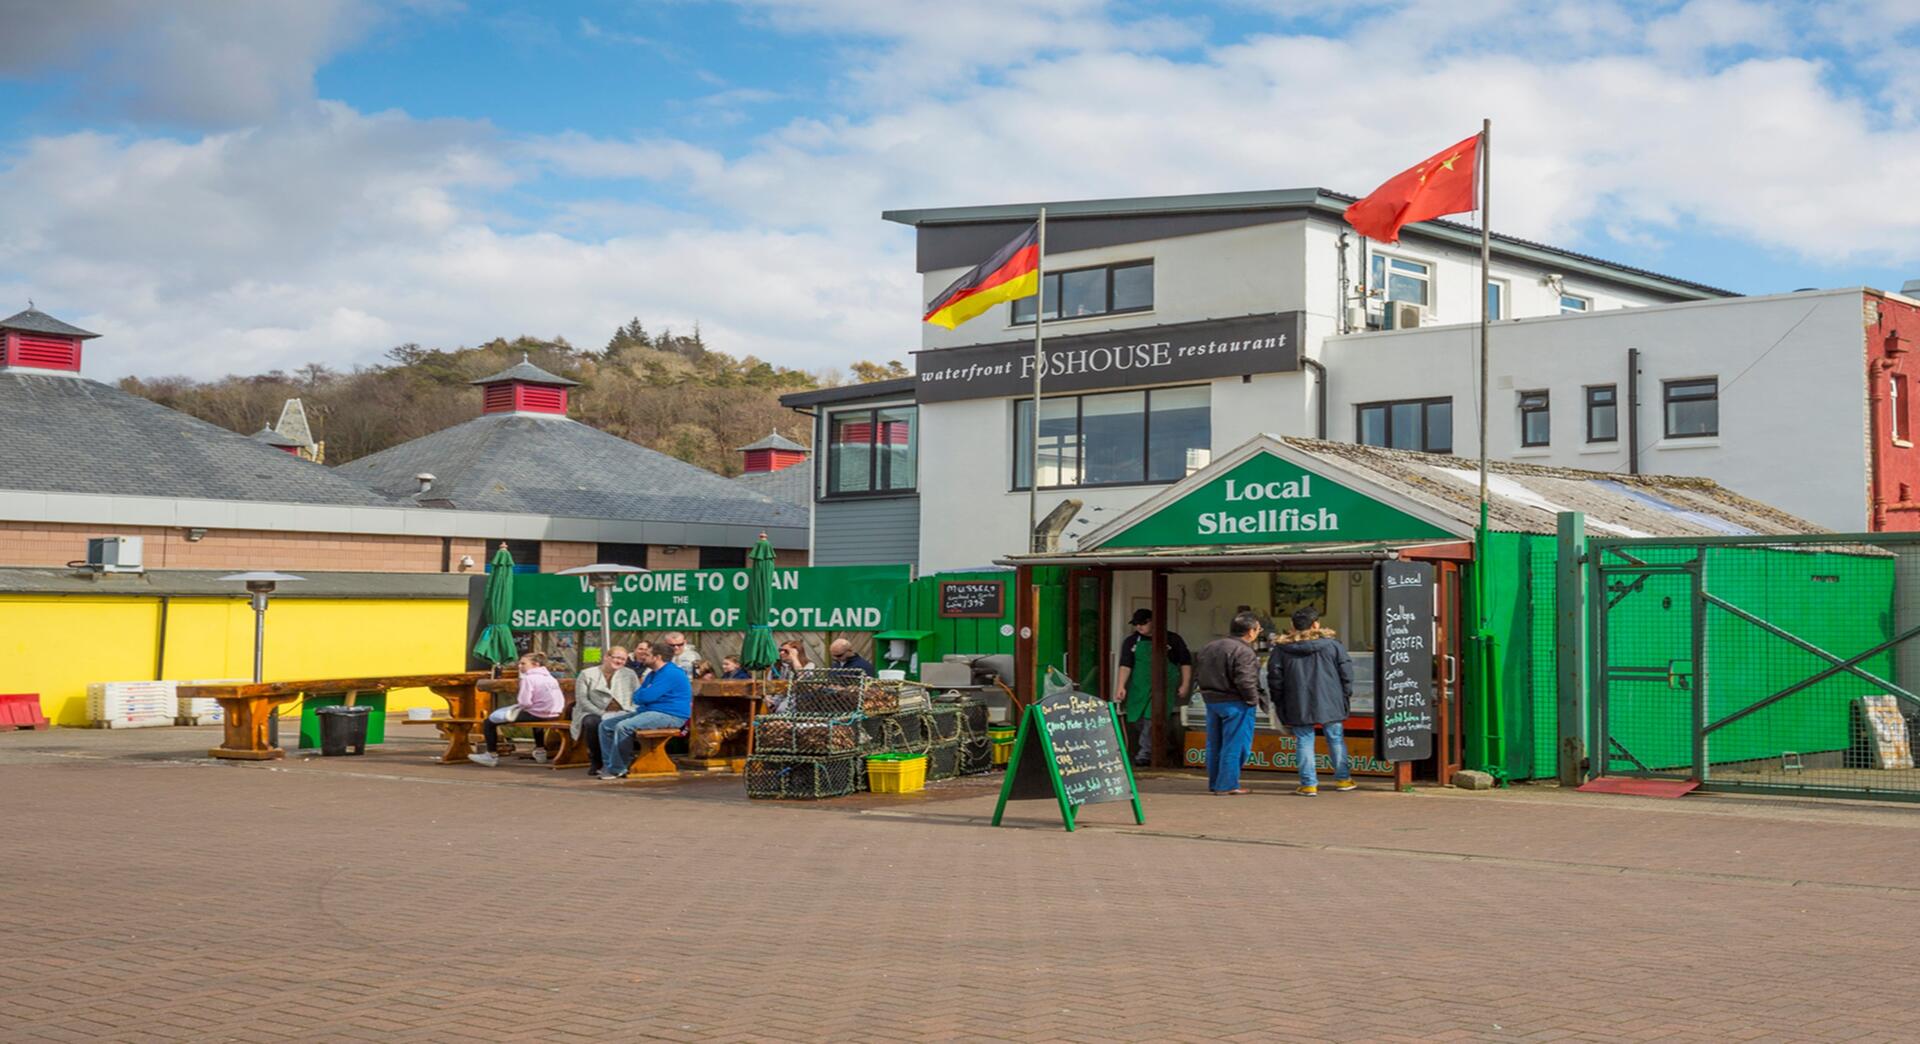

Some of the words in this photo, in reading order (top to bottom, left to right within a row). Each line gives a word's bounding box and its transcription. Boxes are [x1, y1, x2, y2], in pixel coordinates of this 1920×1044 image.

[921, 362, 1013, 382] waterfront
[1178, 334, 1287, 357] restaurant
[1225, 475, 1311, 501] Local
[1198, 507, 1339, 534] Shellfish
[694, 572, 724, 592] TO
[732, 570, 799, 591] OAN
[672, 596, 689, 604] THE
[613, 608, 702, 627] CAPITAL
[710, 608, 740, 627] OF
[767, 608, 881, 628] COTLAND
[1384, 635, 1424, 653] LOBSTER
[1279, 736, 1297, 750] TH
[1272, 751, 1334, 769] GREN
[1346, 754, 1395, 773] SHAC
